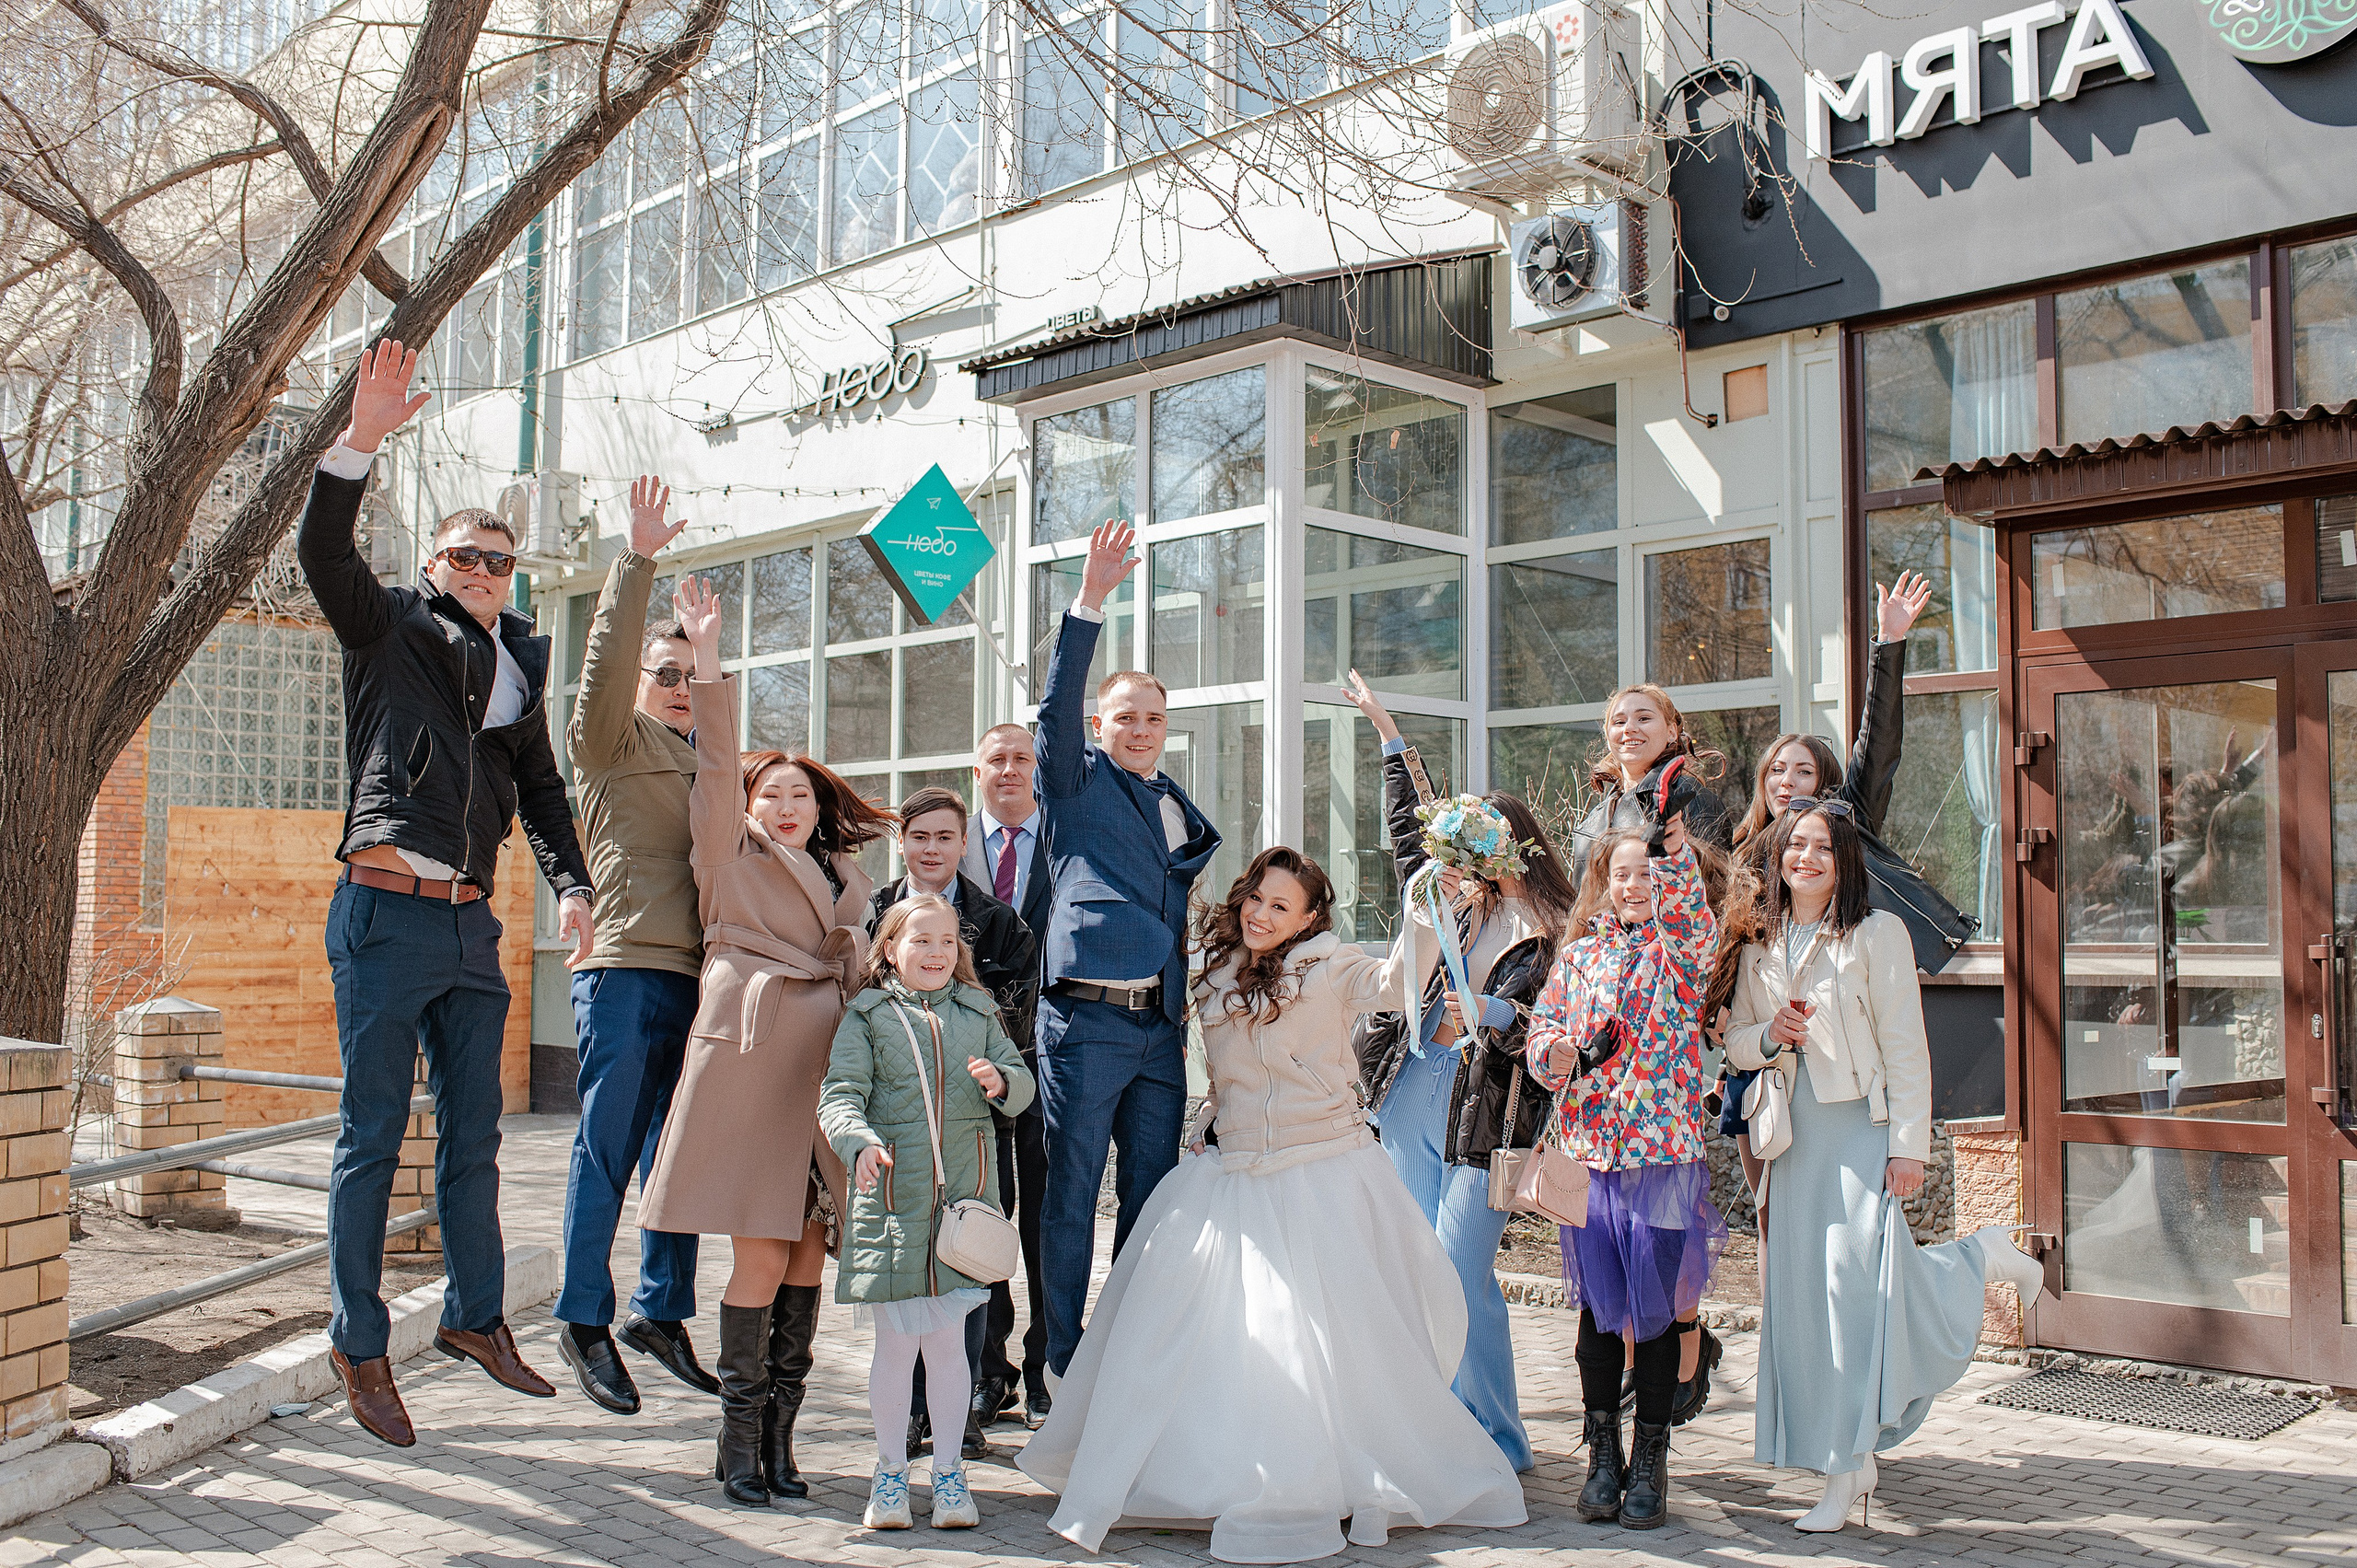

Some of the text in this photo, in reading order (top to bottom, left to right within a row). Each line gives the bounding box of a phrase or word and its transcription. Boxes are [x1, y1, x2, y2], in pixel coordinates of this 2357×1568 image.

[1805, 0, 2155, 161] МЯТА
[1046, 306, 1097, 331] ЦВЕТЫ
[913, 570, 951, 581] ЦВЕТЫ КОФЕ
[927, 579, 944, 587] ВИНО
